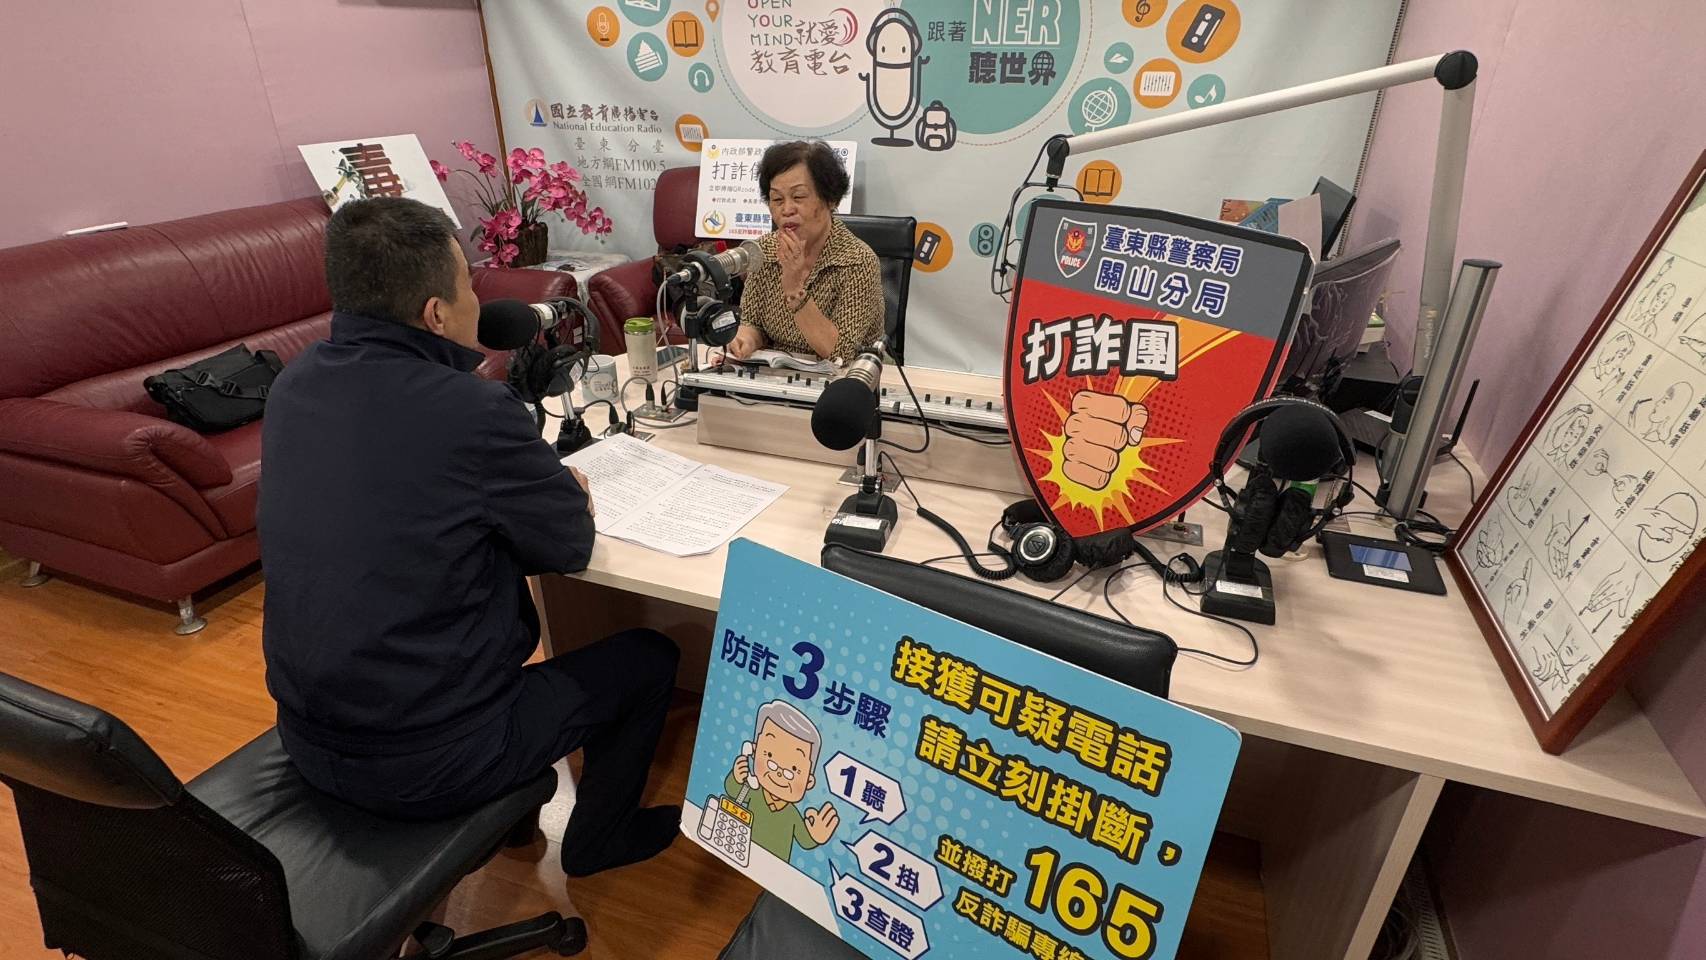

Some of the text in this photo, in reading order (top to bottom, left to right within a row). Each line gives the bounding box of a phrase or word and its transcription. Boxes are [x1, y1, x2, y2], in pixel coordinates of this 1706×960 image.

[748, 0, 792, 9] OPEN
[747, 14, 793, 27] YOUR
[927, 20, 967, 43] 跟著
[971, 0, 1061, 45] NER
[750, 34, 793, 46] MIND
[750, 47, 852, 75] 教育電台
[968, 51, 1056, 86] 聽世界
[553, 121, 662, 133] National Education Radio
[721, 146, 766, 156] 內政部警政
[1060, 255, 1081, 268] POLICE
[1102, 224, 1243, 276] 臺東縣警察局
[1095, 258, 1230, 318] 關山分局
[1024, 316, 1178, 379] 打詐團
[893, 638, 1169, 794] 接獲可疑電話
[937, 837, 1159, 959] 並撥打 165
